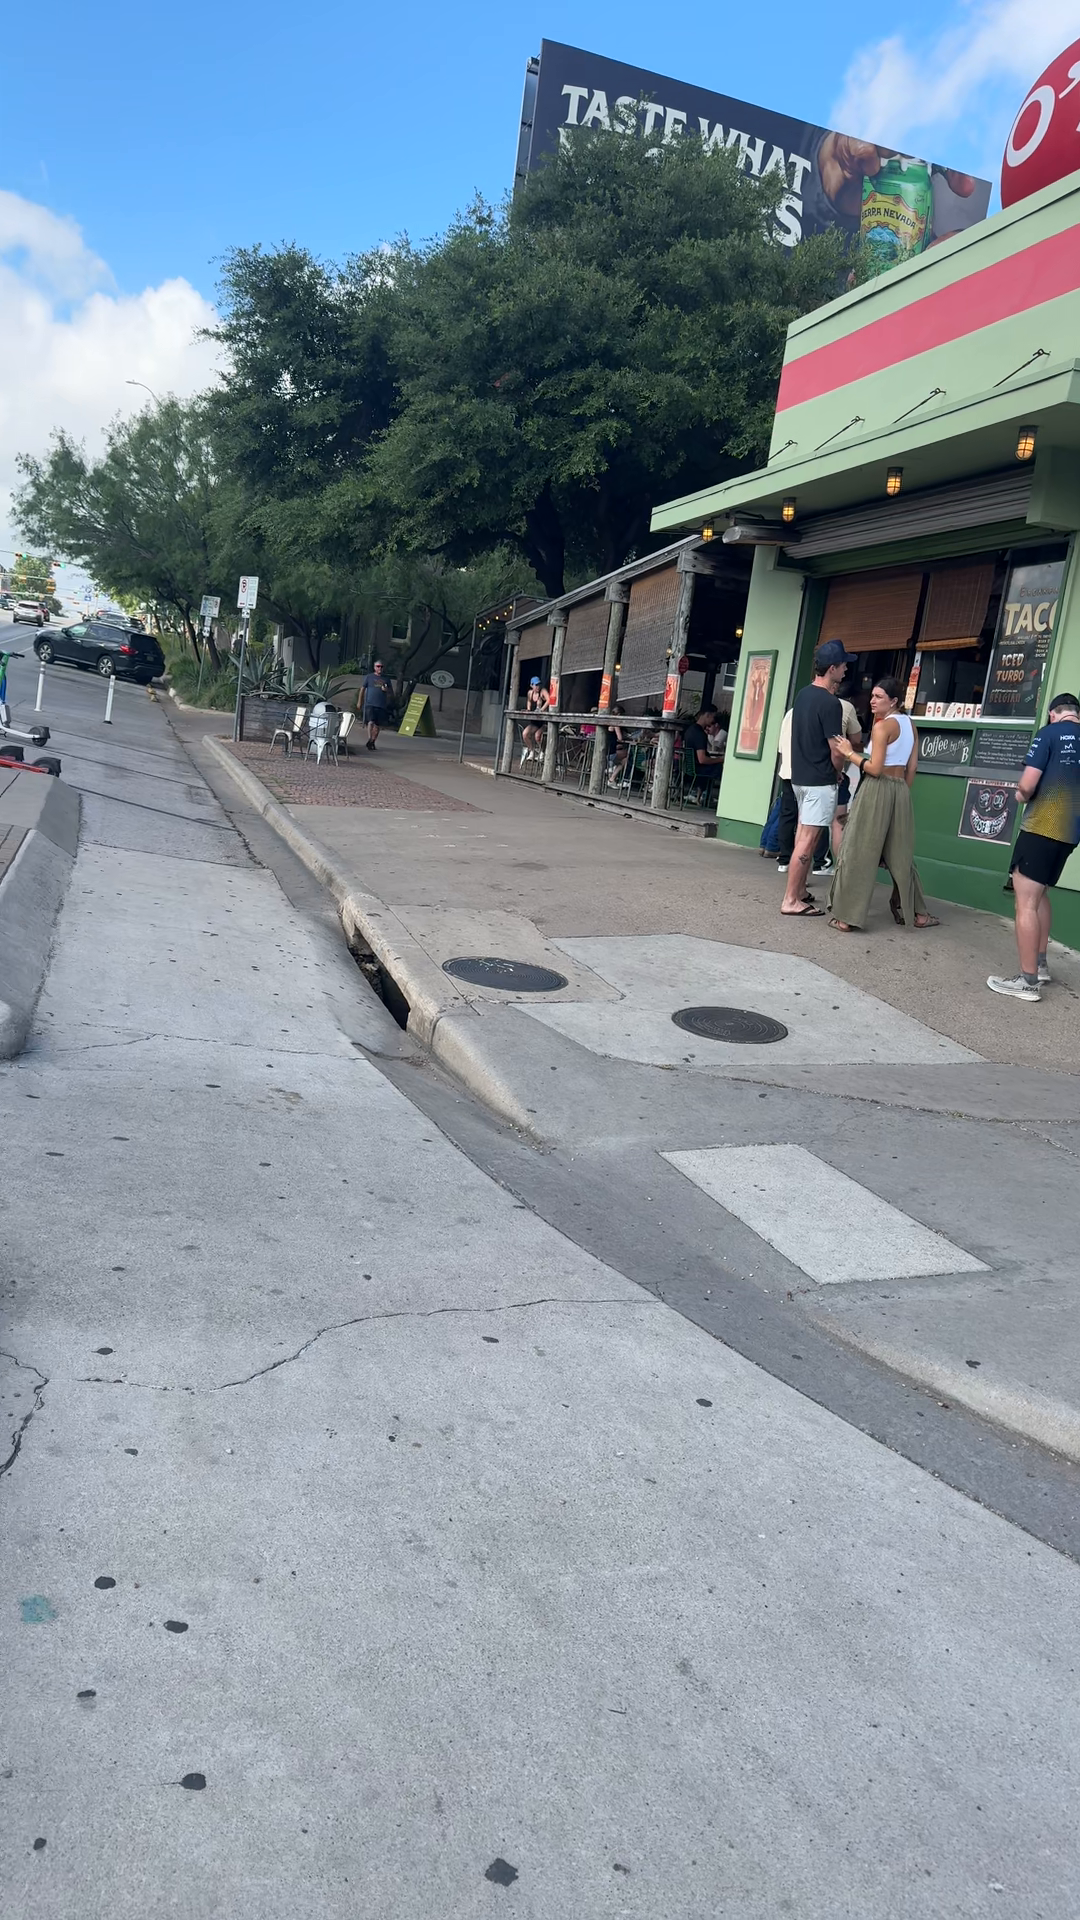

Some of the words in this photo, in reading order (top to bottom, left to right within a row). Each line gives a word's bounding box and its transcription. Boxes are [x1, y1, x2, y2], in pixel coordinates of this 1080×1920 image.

[561, 85, 687, 148] TASTE
[698, 117, 811, 195] WHAT
[884, 208, 916, 229] NEVADA
[1002, 653, 1024, 666] ICED
[996, 670, 1025, 682] TURBO
[921, 735, 949, 757] Coffee
